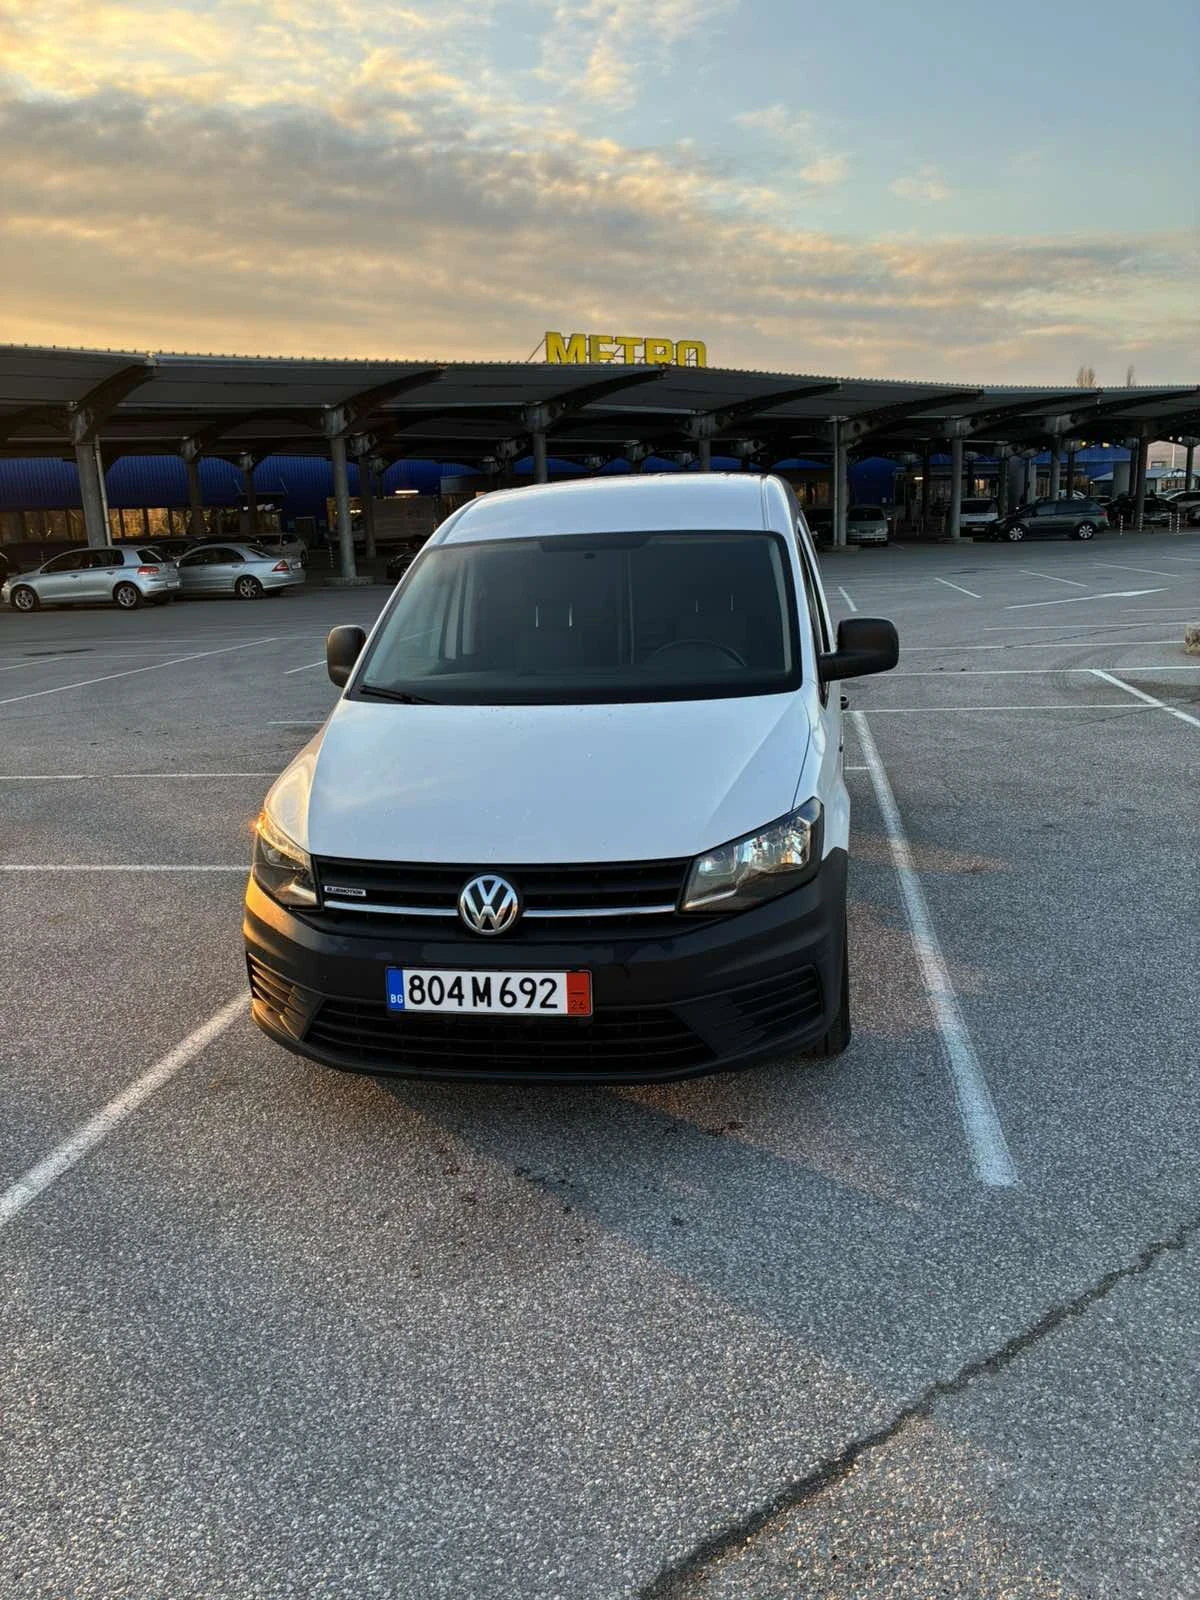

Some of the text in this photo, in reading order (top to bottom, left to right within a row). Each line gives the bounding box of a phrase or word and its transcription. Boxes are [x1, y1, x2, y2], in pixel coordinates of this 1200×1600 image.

[545, 331, 707, 368] METRO
[460, 875, 518, 935] VW
[390, 994, 403, 1003] BG
